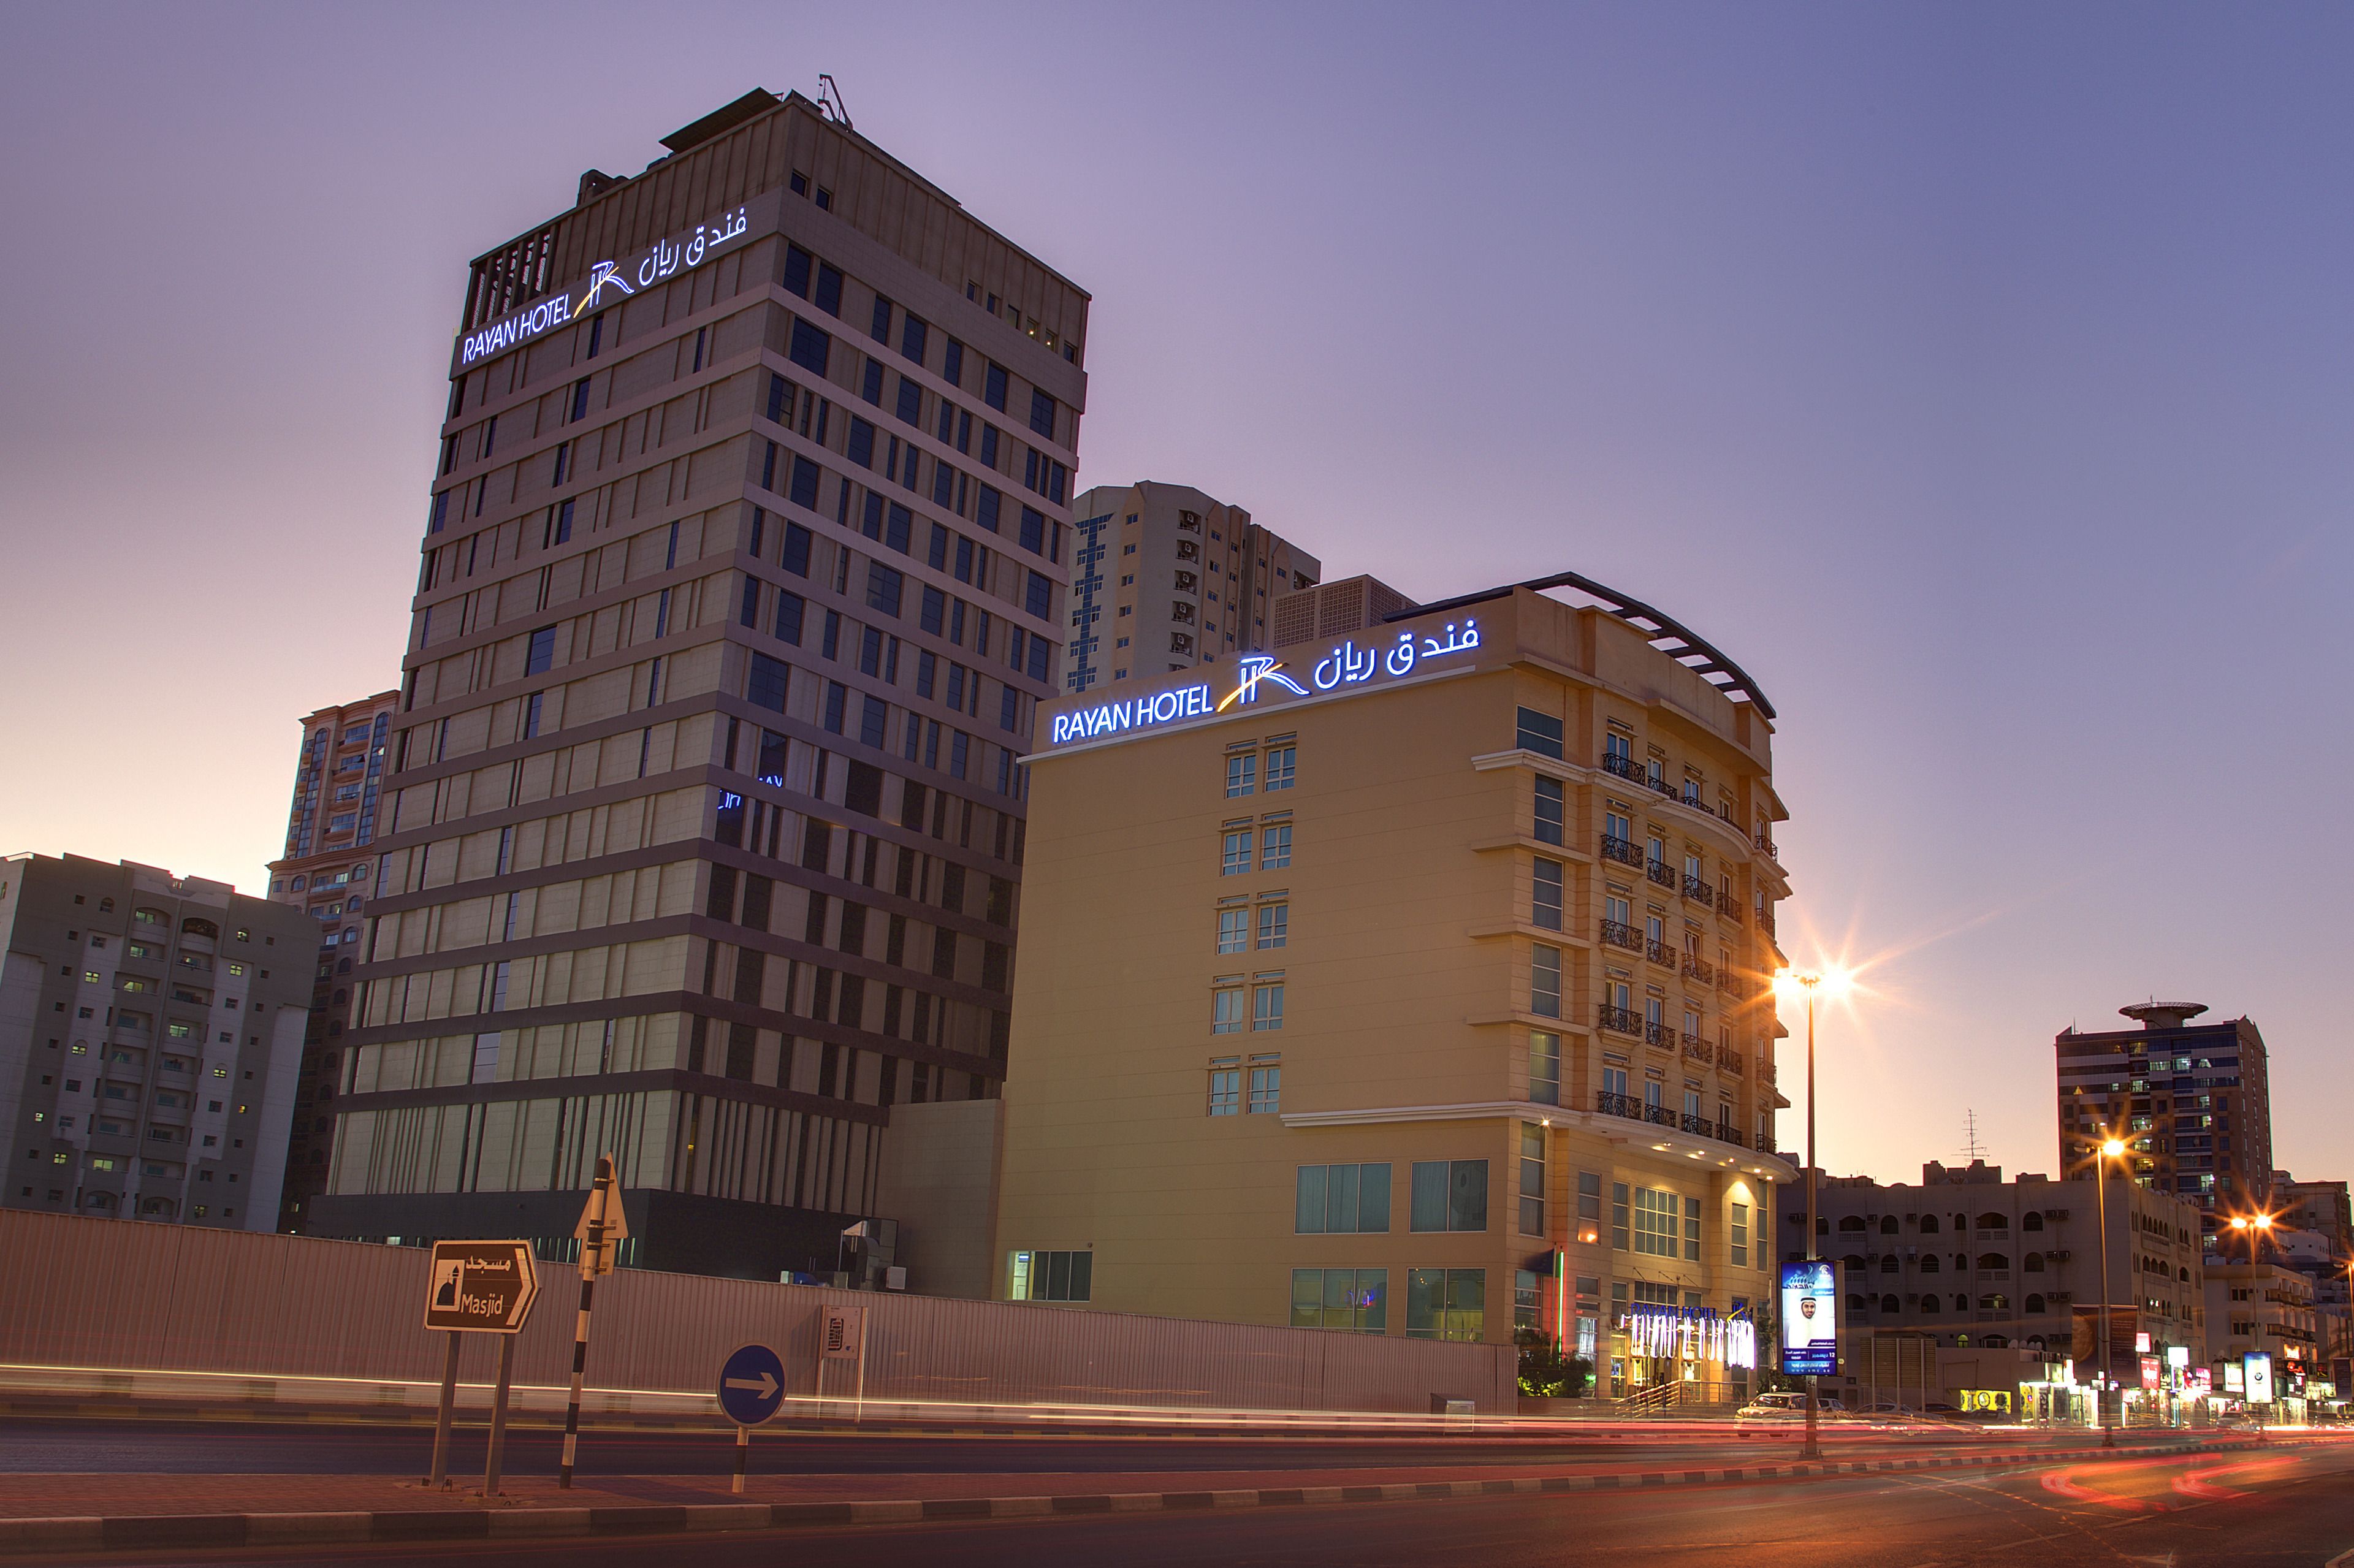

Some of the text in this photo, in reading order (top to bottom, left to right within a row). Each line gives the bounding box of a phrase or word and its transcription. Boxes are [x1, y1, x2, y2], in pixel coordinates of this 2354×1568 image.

[639, 208, 747, 286] فندق ريان
[462, 294, 571, 364] RAYAN HOTEL
[1314, 619, 1480, 690] فندق ريان
[1053, 685, 1214, 744] RAYAN HOTEL
[466, 1255, 511, 1274] مسجد
[460, 1293, 504, 1318] Masjid
